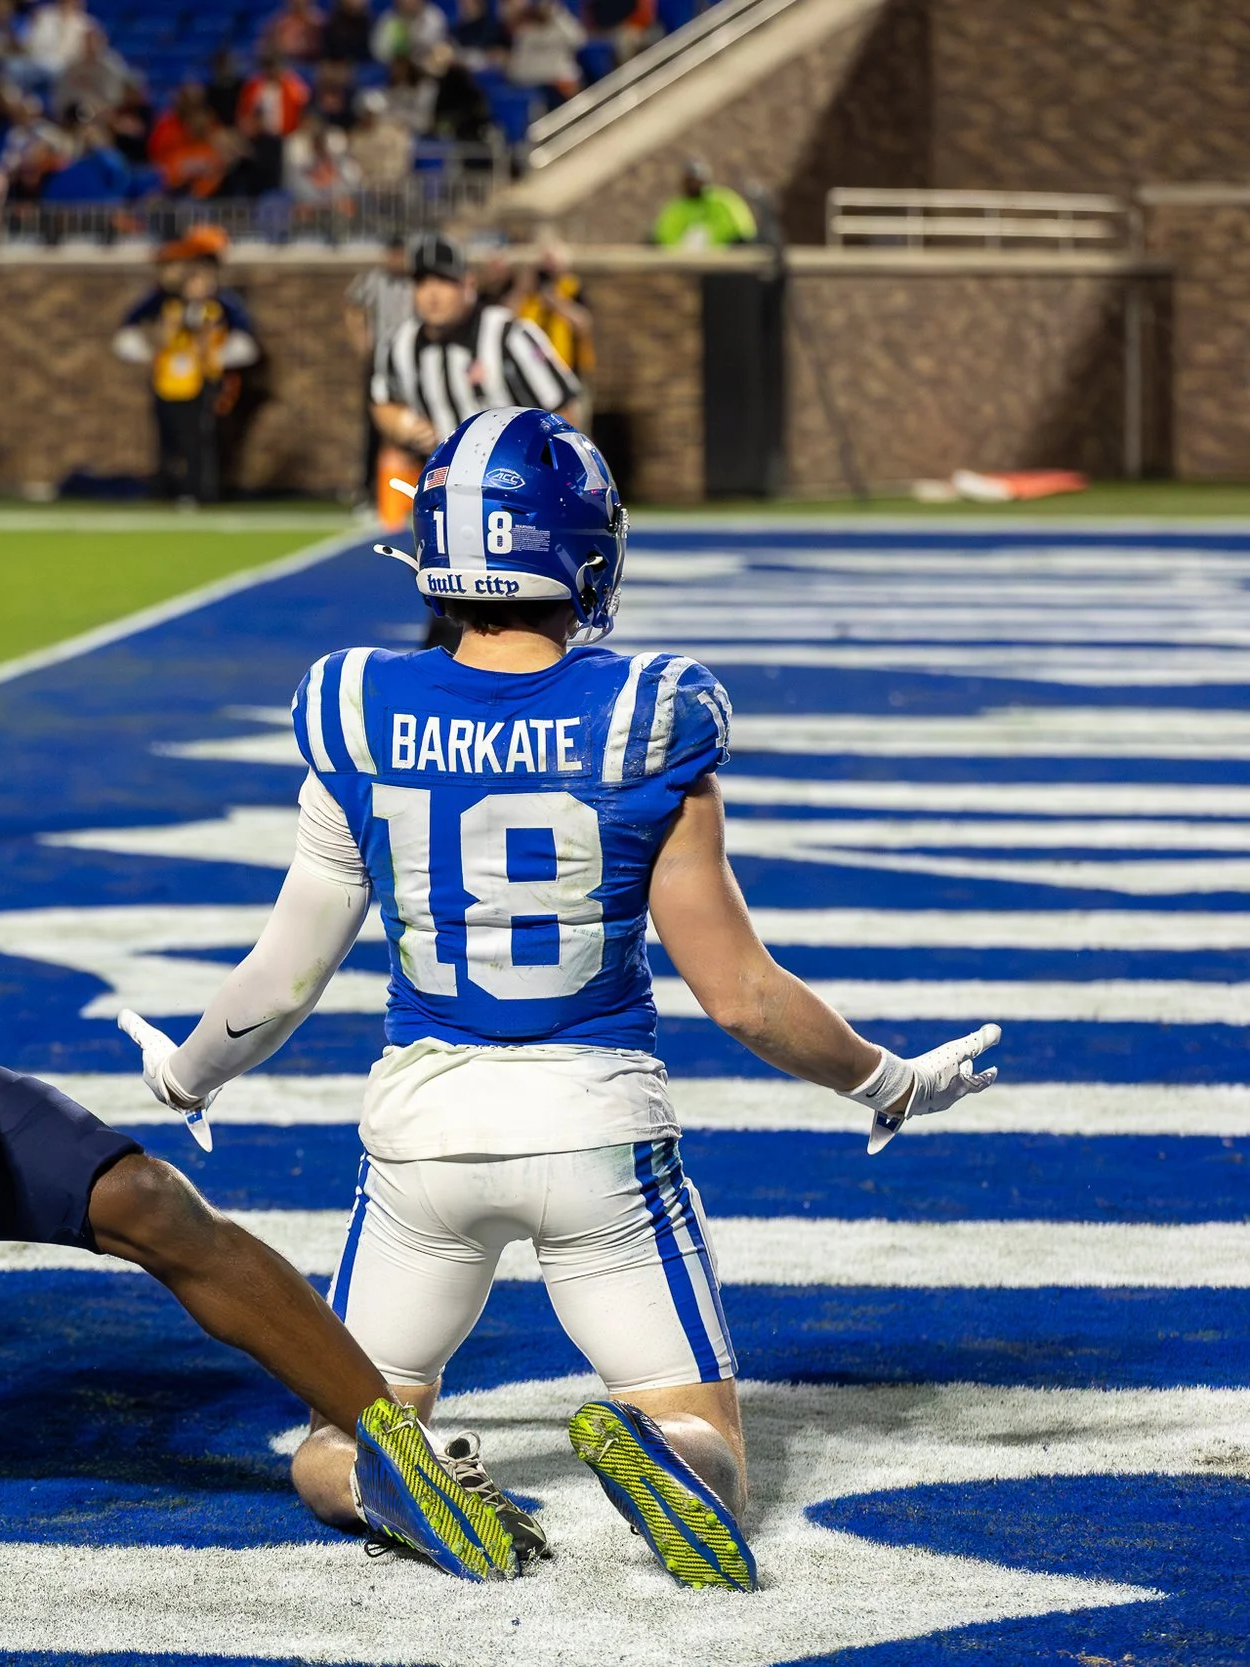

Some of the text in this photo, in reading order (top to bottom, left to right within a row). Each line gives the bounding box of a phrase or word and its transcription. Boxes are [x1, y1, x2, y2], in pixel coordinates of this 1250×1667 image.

[494, 473, 519, 486] ACC
[433, 511, 446, 554] 1
[487, 511, 513, 554] 8
[427, 574, 520, 597] bull city
[391, 714, 582, 774] BARKATE
[372, 783, 604, 1000] 18
